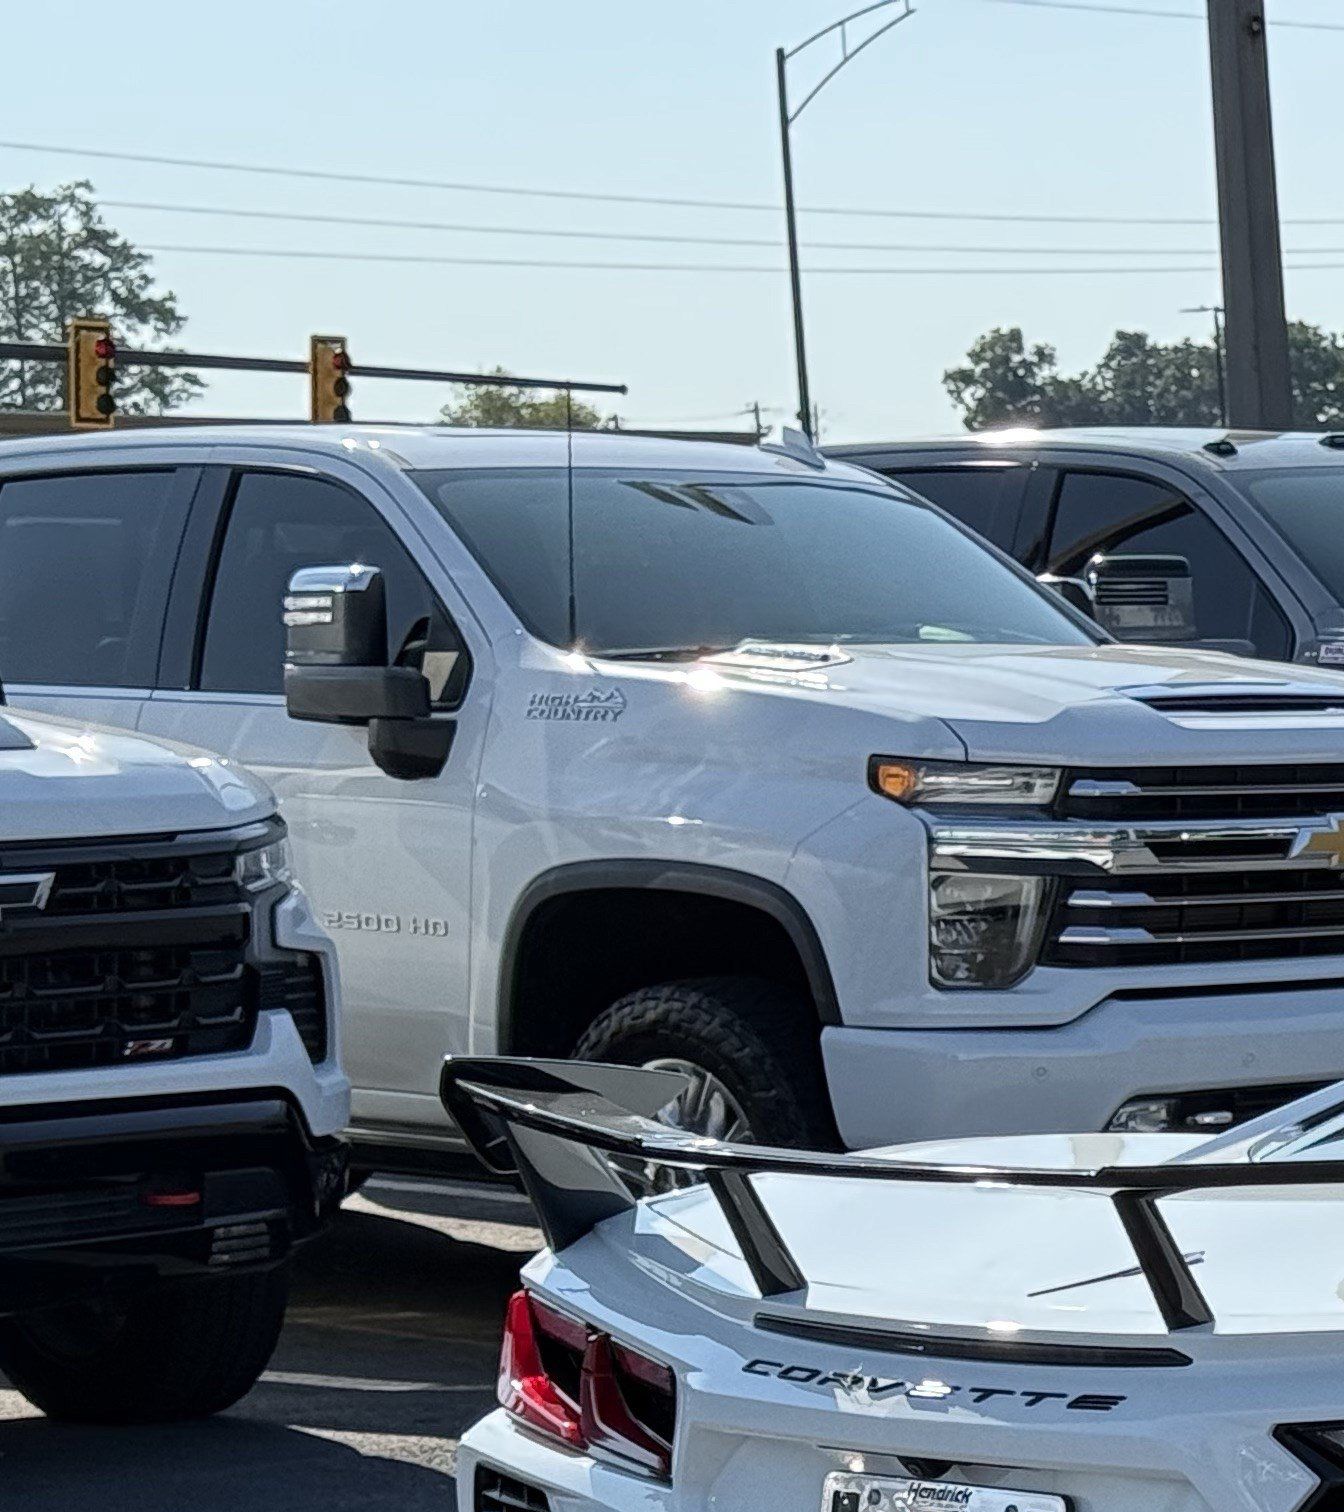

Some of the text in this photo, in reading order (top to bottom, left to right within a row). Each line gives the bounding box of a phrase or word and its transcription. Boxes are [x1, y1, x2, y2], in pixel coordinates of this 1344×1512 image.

[530, 693, 580, 706] HIGH
[525, 707, 624, 722] COUNTRY
[322, 911, 449, 937] 2500 HD
[741, 1357, 1128, 1412] CORVETTE
[908, 1482, 974, 1505] Hendrick
